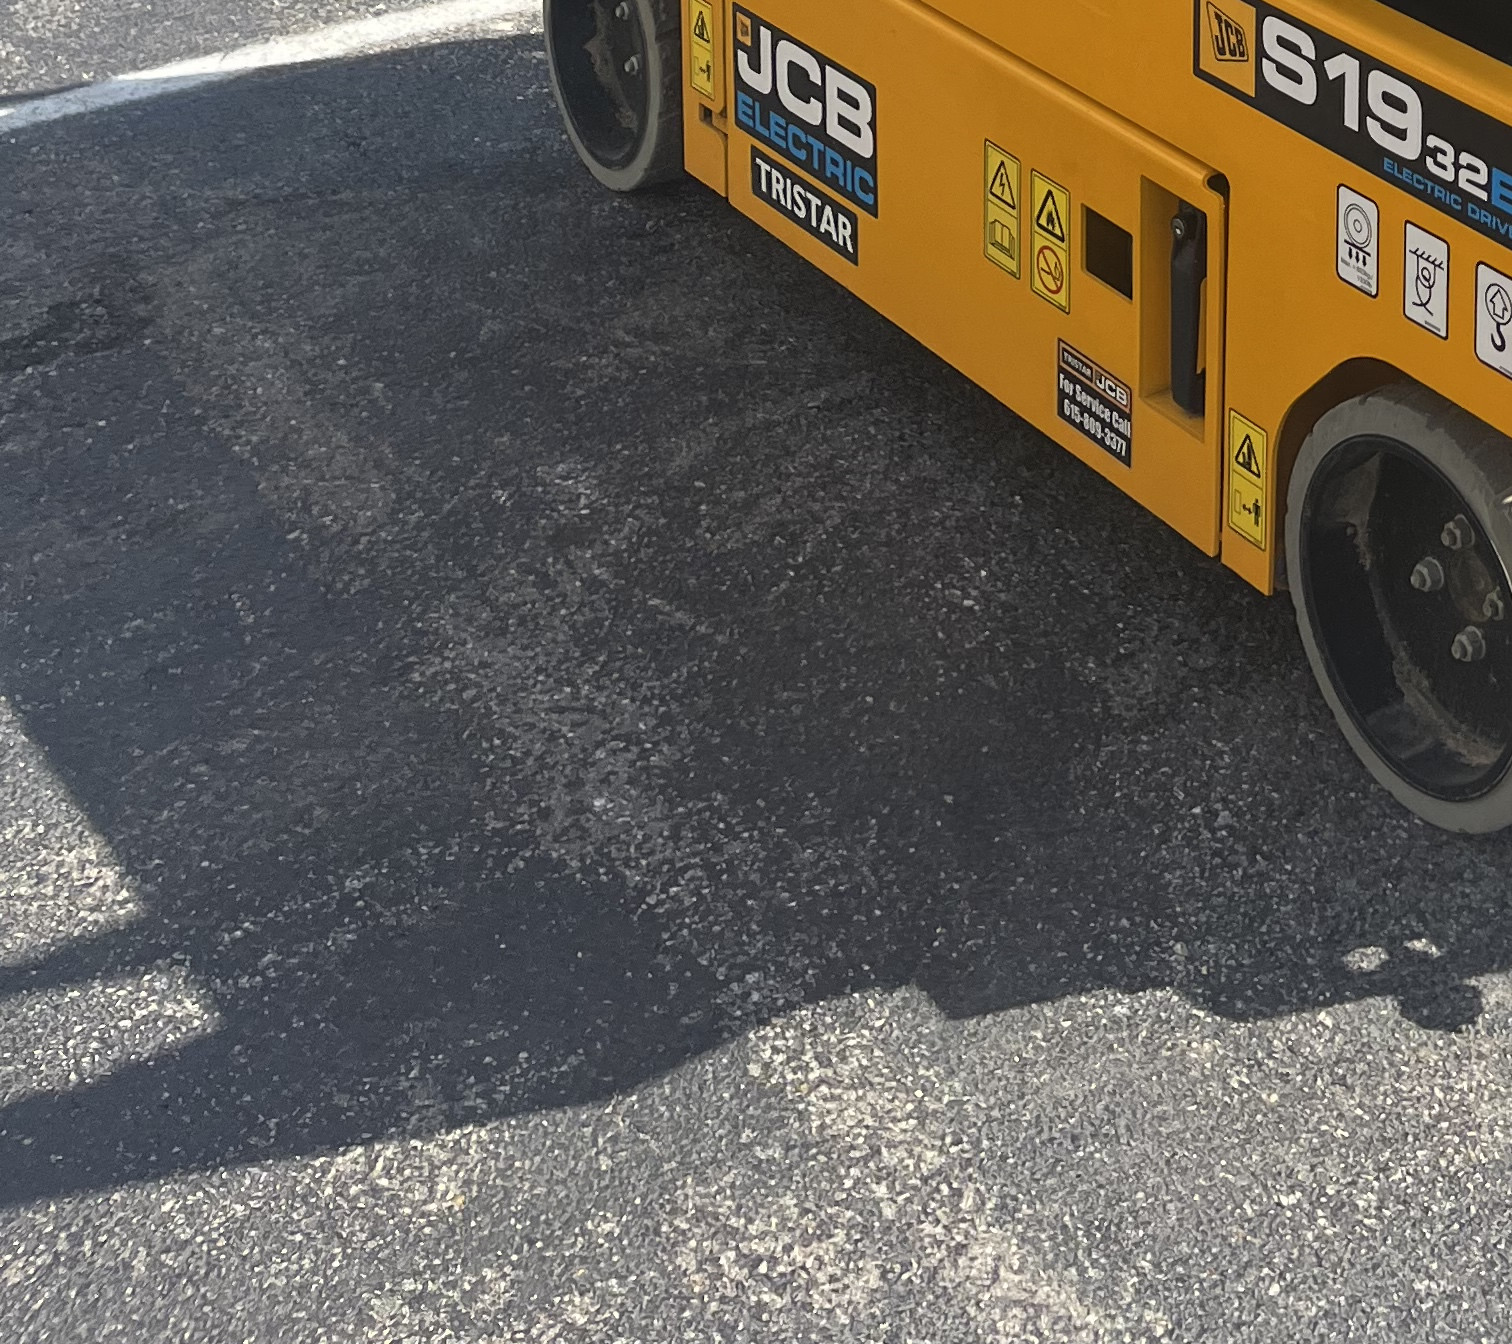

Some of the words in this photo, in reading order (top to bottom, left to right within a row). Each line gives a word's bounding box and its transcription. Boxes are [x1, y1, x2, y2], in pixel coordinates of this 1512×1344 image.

[1213, 10, 1246, 58] JCB
[737, 25, 874, 159] JCB
[736, 89, 875, 206] ELECTRIC
[755, 157, 854, 254] TRISTAR
[1383, 157, 1462, 211] ELECTRIC
[1060, 373, 1074, 396] For
[1075, 384, 1110, 423] Service
[1112, 411, 1131, 438] Call
[1096, 375, 1127, 406] JCB
